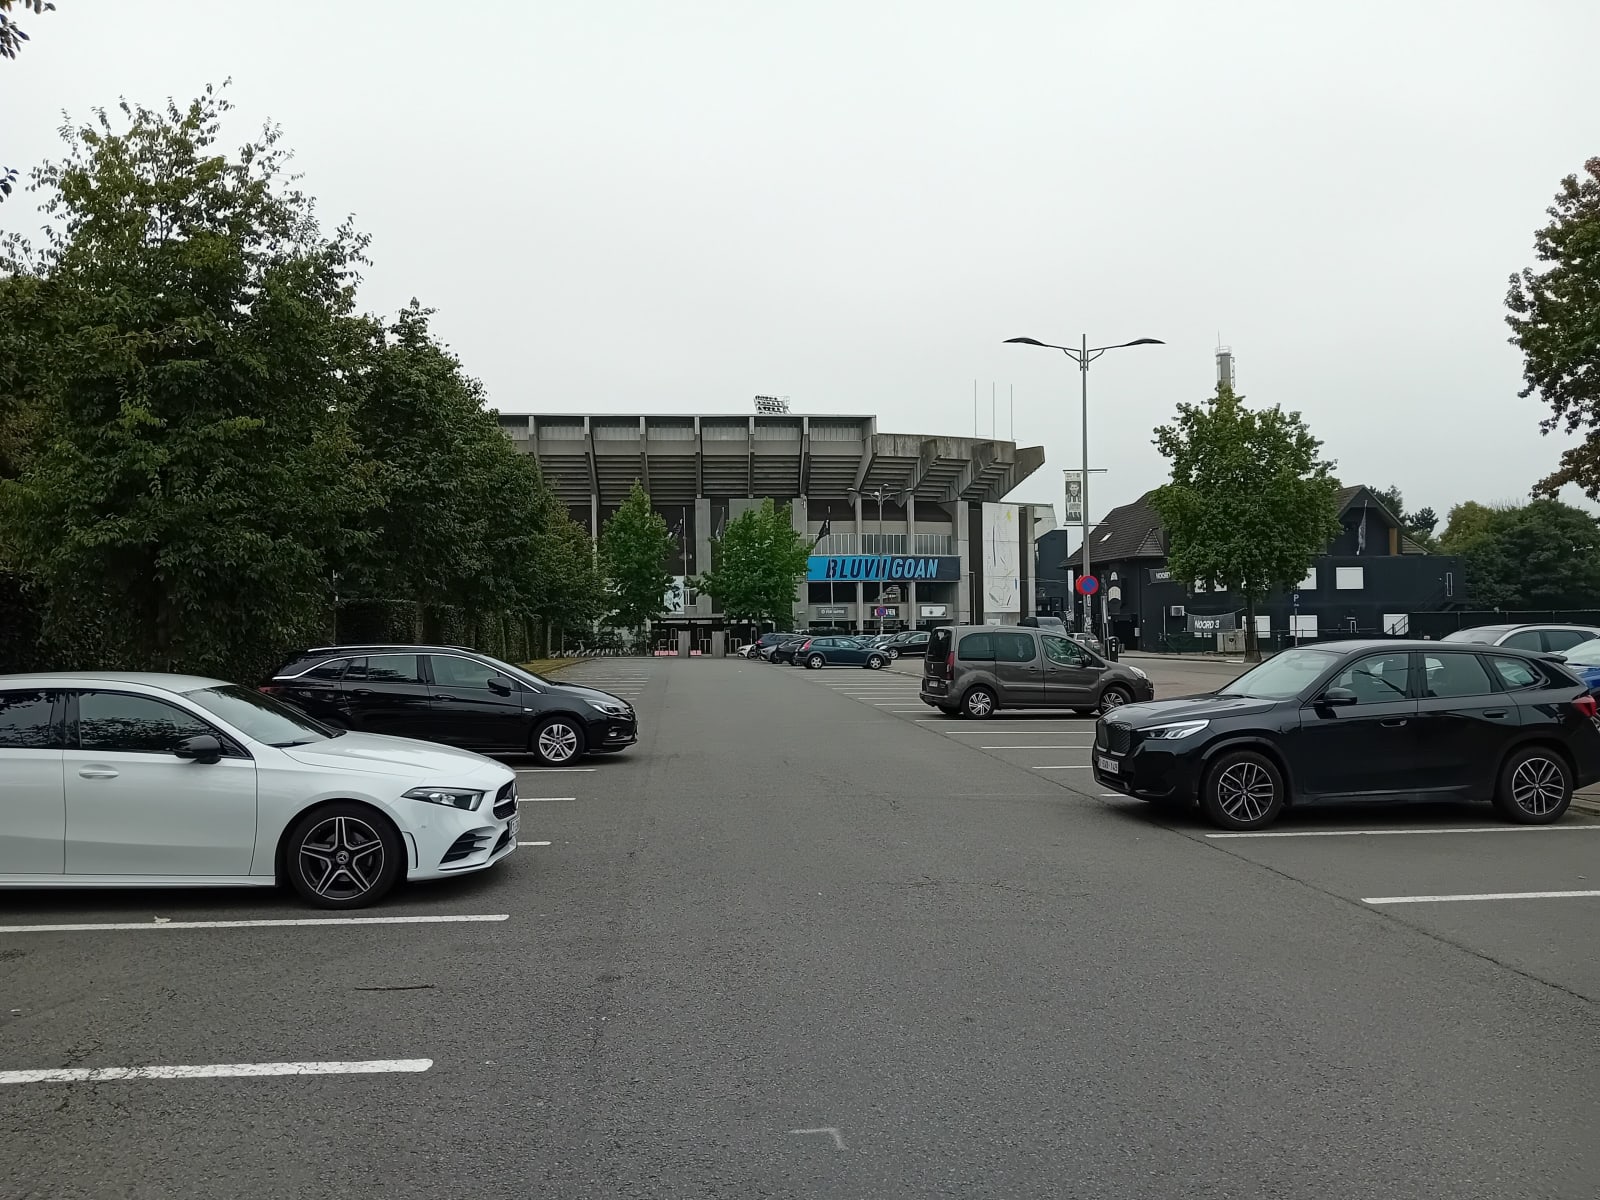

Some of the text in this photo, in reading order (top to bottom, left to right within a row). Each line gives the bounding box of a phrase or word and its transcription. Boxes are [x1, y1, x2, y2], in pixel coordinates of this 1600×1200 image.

[891, 558, 939, 578] GOAN
[1293, 593, 1300, 602] P
[1194, 619, 1220, 629] NOORD 3
